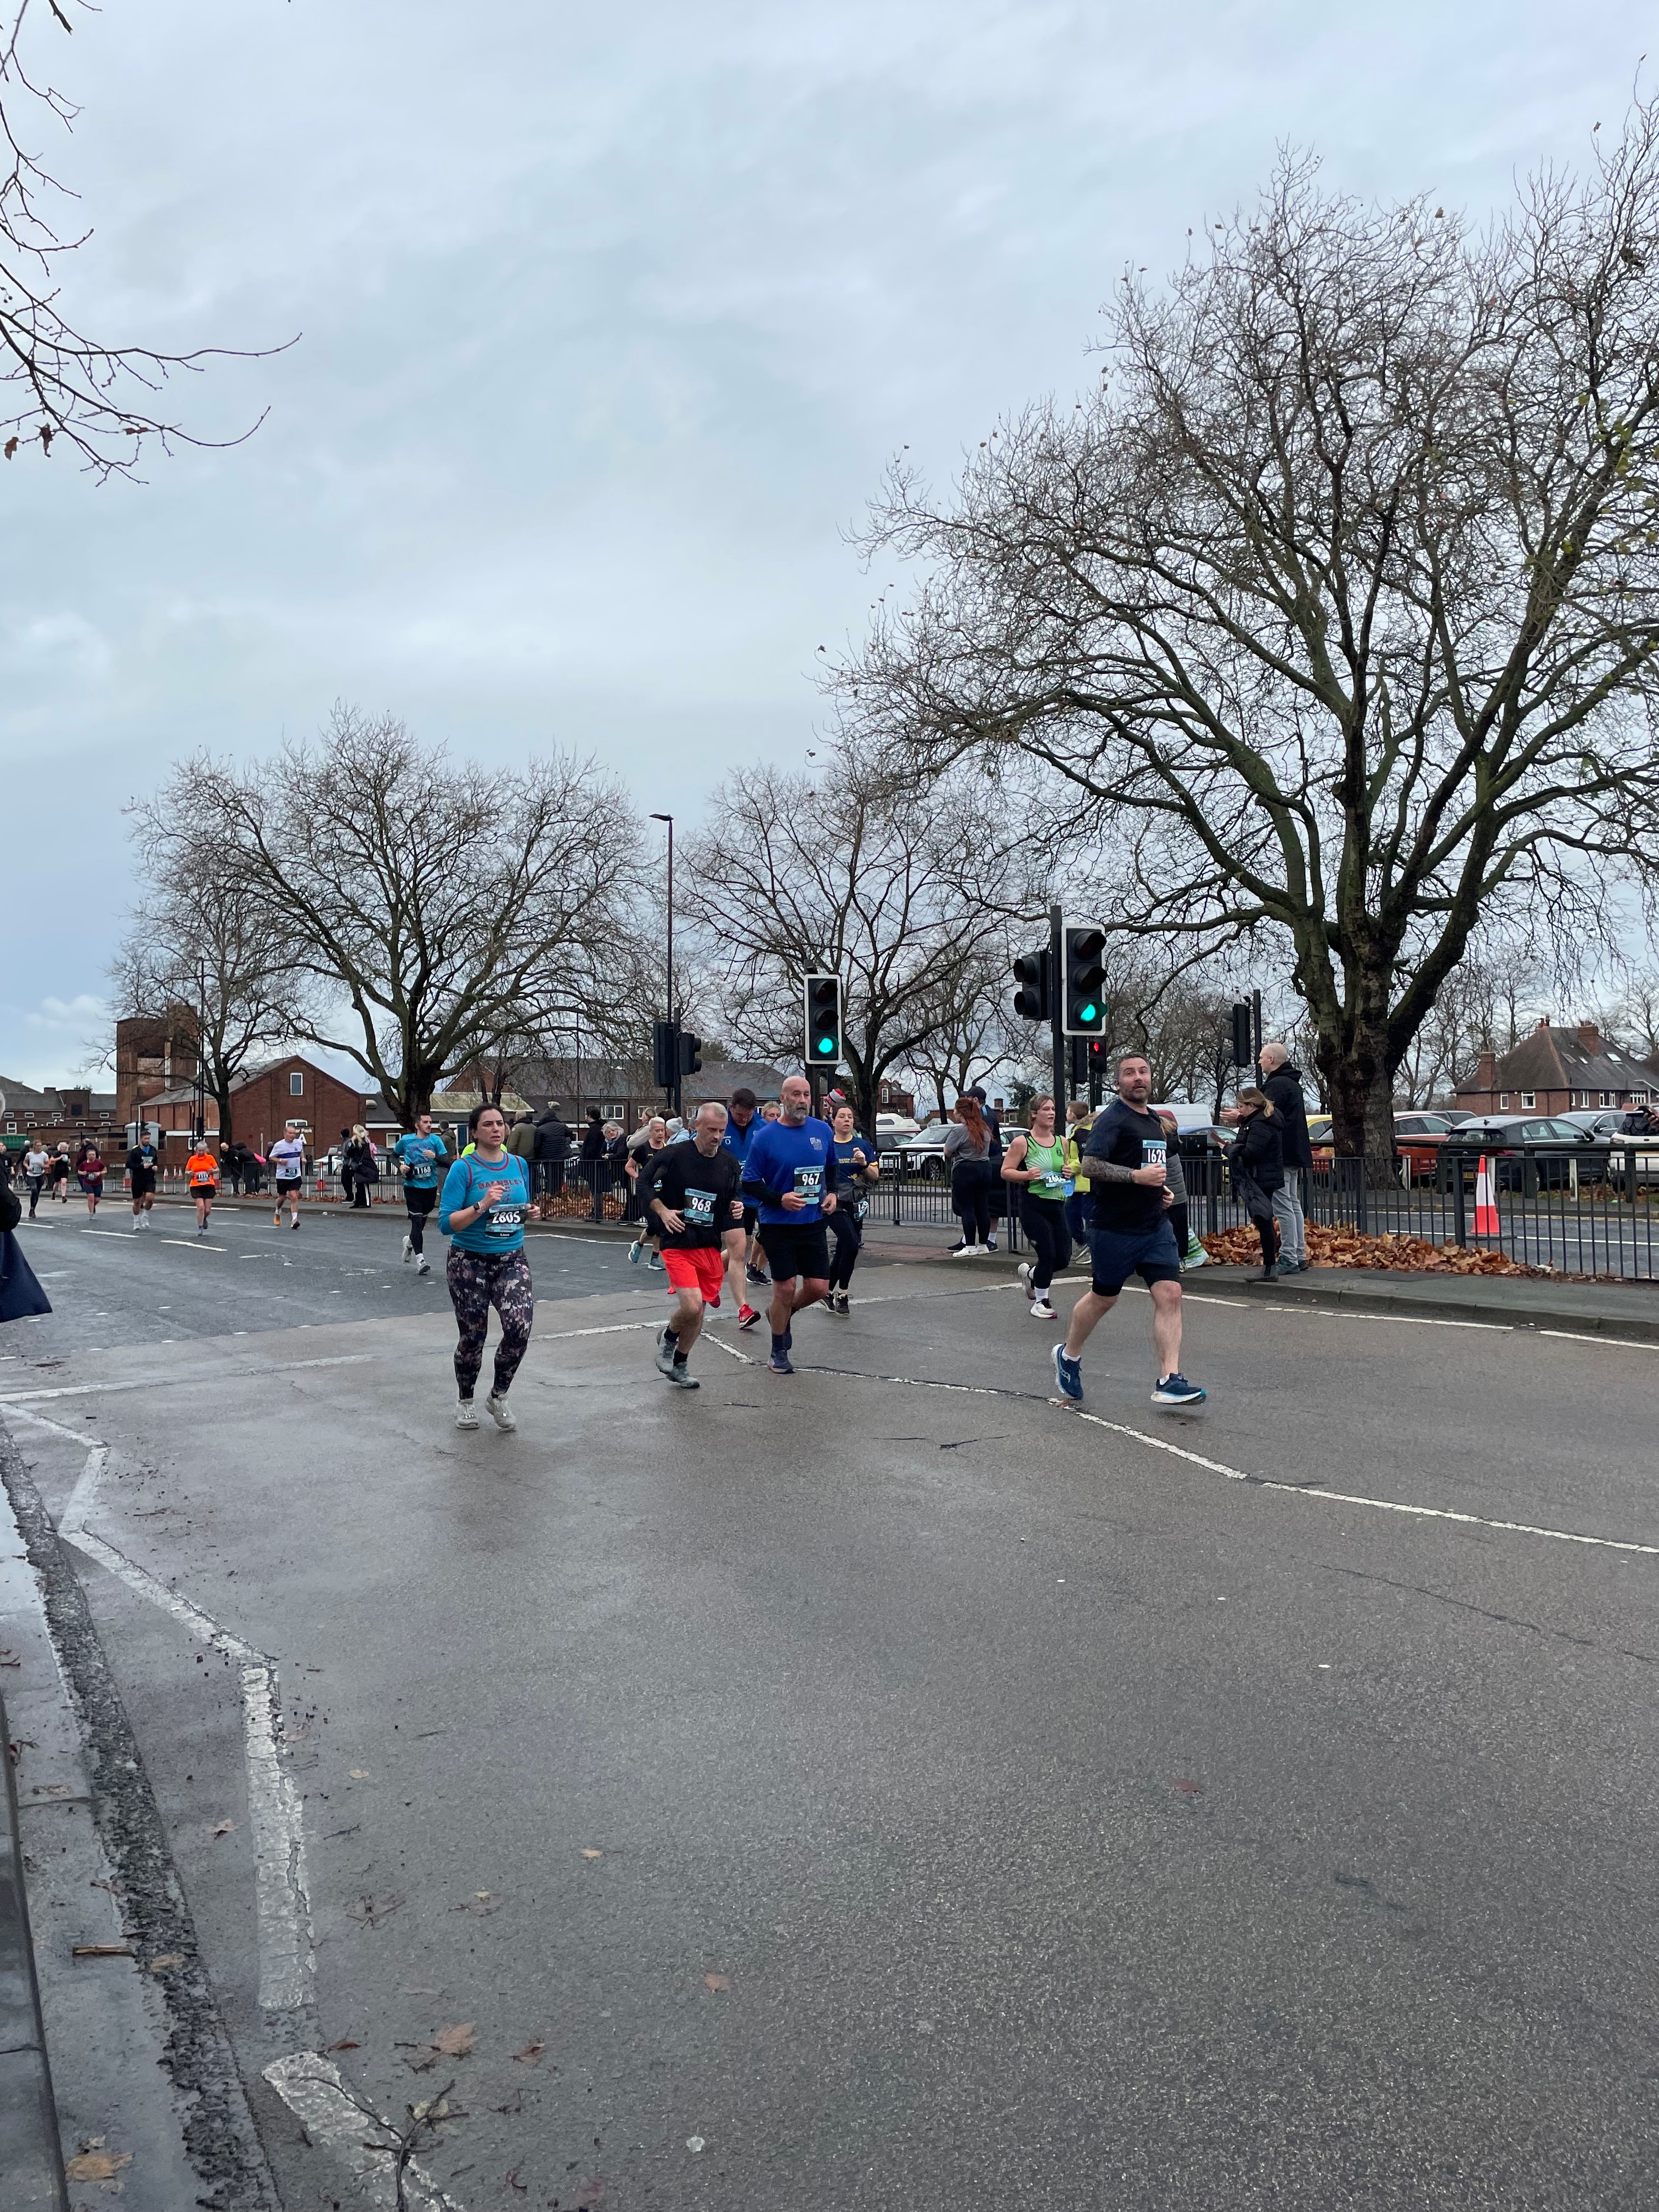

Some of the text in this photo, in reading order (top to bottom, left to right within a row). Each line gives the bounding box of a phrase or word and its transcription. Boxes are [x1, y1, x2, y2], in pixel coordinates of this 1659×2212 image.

[298, 1133, 307, 1144] A
[1148, 1148, 1166, 1164] 1628
[802, 1173, 820, 1186] 967
[692, 1197, 712, 1212] 968
[492, 1210, 521, 1224] 2805
